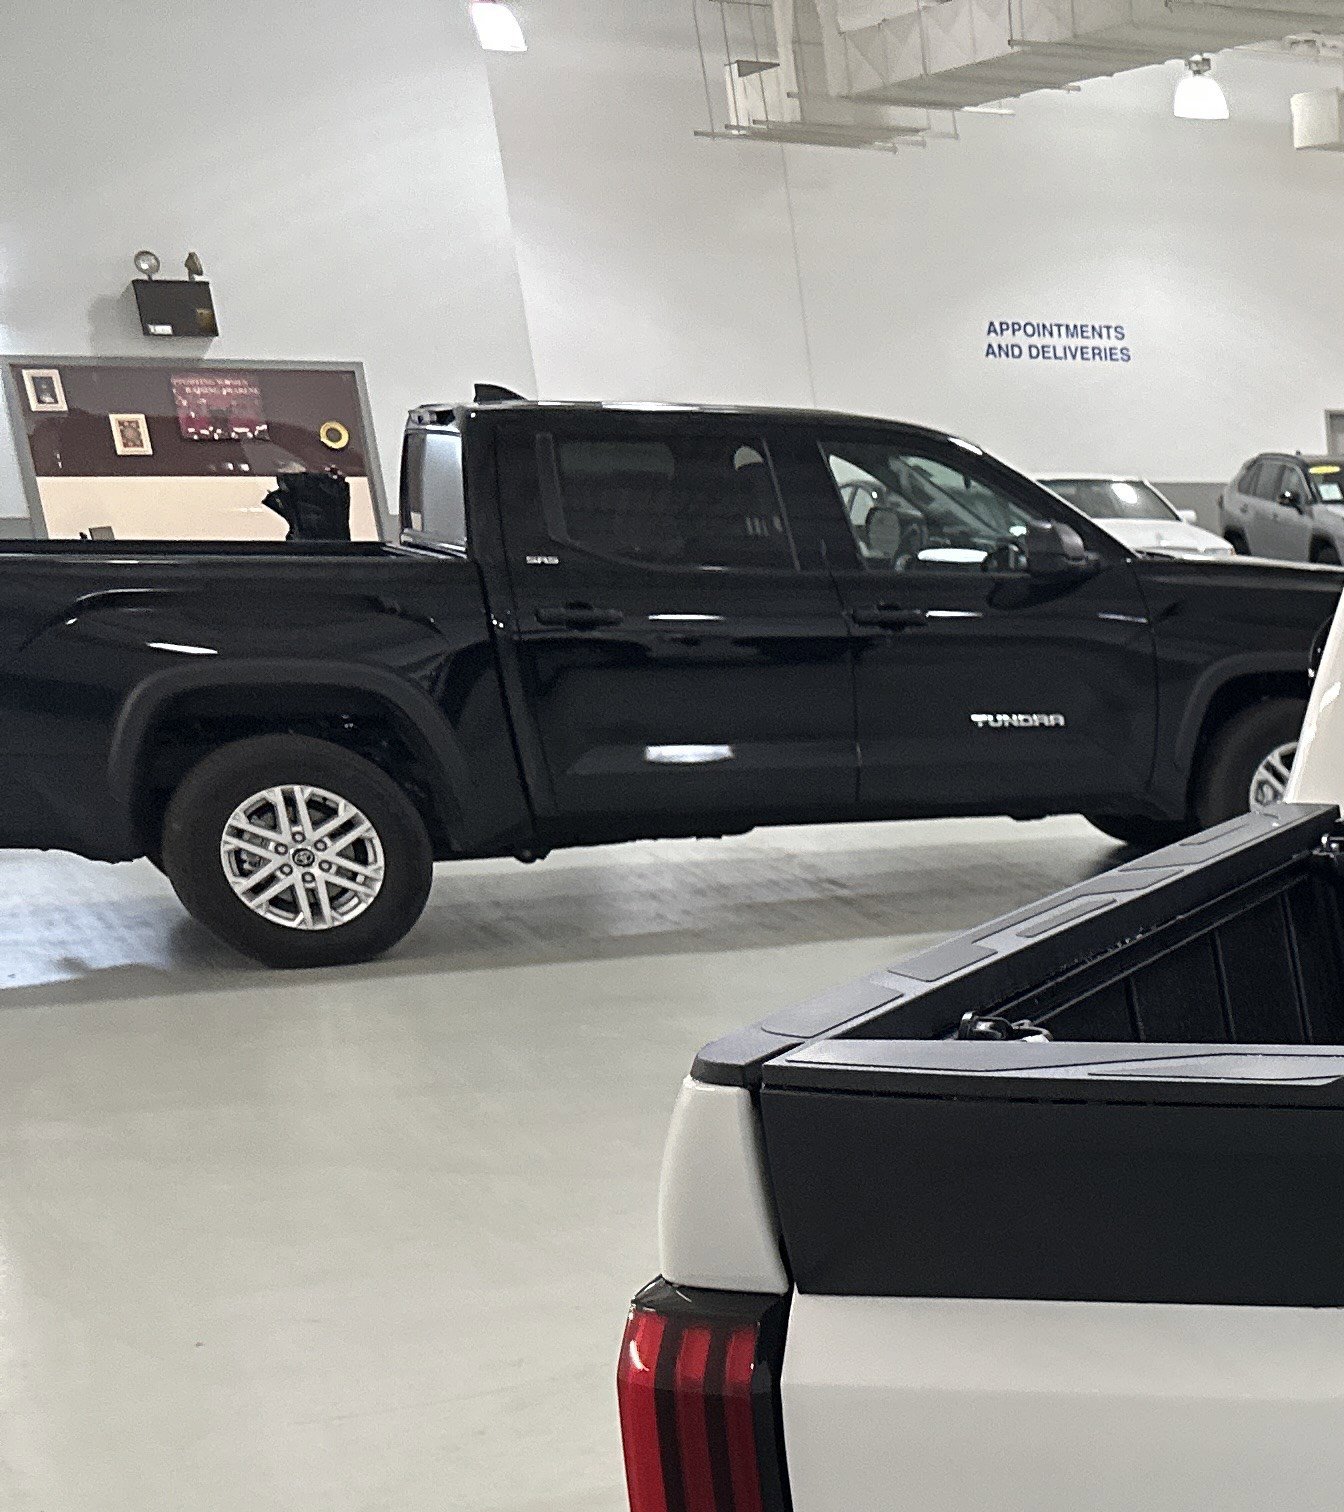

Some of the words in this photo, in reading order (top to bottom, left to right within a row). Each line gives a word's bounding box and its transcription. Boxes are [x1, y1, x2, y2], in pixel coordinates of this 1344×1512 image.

[987, 321, 1126, 341] APPOINTMENTS
[985, 343, 1023, 359] AND
[1028, 344, 1131, 363] DELIVERIES
[970, 713, 1065, 728] TUNDRA
